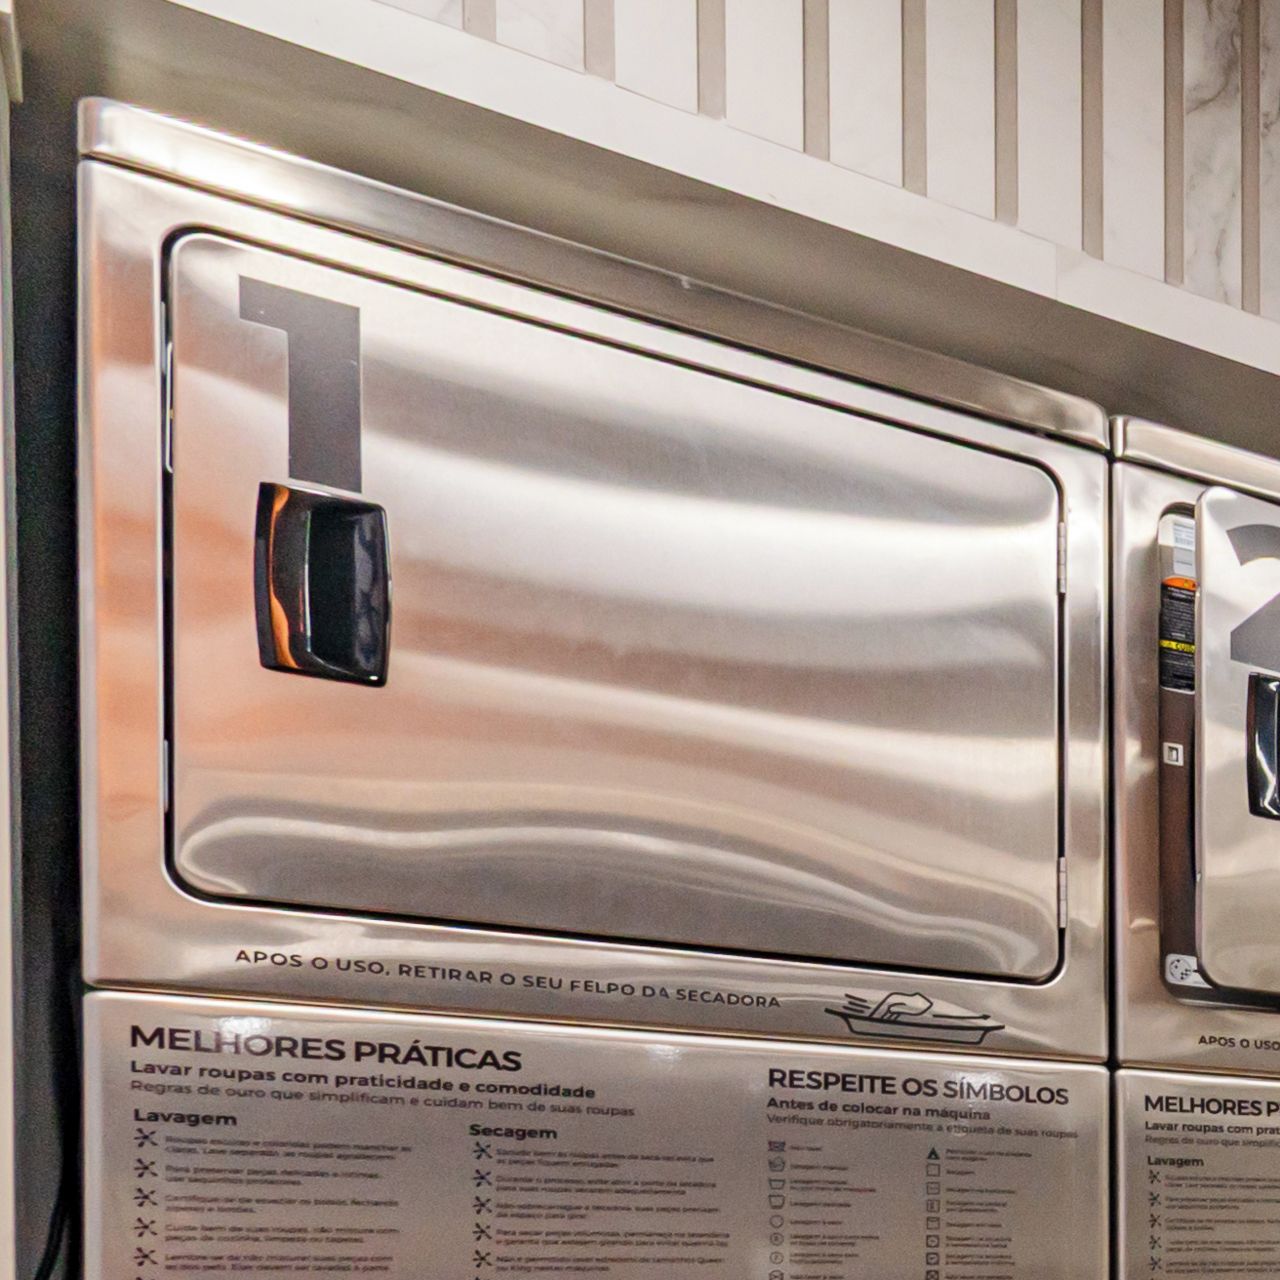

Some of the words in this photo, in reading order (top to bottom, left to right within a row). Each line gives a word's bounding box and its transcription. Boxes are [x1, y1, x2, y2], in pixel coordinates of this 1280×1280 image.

[239, 275, 362, 493] 1
[235, 950, 302, 968] APOS
[312, 956, 328, 970] O
[336, 958, 389, 977] USO,
[399, 964, 492, 983] RETIRAR
[500, 972, 515, 985] O
[523, 974, 562, 989] SEU
[571, 978, 634, 995] FELPO
[642, 984, 669, 998] DA
[676, 987, 781, 1007] SECADORA
[131, 1025, 345, 1061] MELHORES
[354, 1040, 522, 1072] PRÁTICAS
[1199, 1035, 1235, 1047] APOS
[1240, 1040, 1249, 1049] O
[131, 1060, 190, 1076] Lavar
[199, 1068, 276, 1085] roupas
[282, 1072, 328, 1085] com
[336, 1072, 453, 1091] praticidade
[459, 1082, 471, 1092] e
[475, 1080, 596, 1099] comodidade
[769, 1069, 896, 1095] RESPEITE
[902, 1078, 938, 1096] OS
[943, 1077, 1069, 1105] SÍMBOLOS
[131, 1080, 191, 1099] Regras
[197, 1085, 221, 1097] de
[271, 1089, 301, 1104] que
[424, 1096, 483, 1110] cuidam
[489, 1099, 521, 1111] bem
[587, 1106, 635, 1119] roupas
[767, 1097, 814, 1111] Antes
[819, 1099, 838, 1112] de
[842, 1102, 898, 1115] colocar
[903, 1107, 921, 1116] na
[925, 1106, 990, 1122] máquina
[1145, 1095, 1262, 1116] MELHORES
[134, 1109, 237, 1128] Lavagem
[1145, 1121, 1178, 1131] Lavar
[1182, 1124, 1224, 1135] roupas
[1227, 1126, 1253, 1134] com
[470, 1124, 557, 1142] Secagem
[1148, 1156, 1204, 1168] Lavagem
